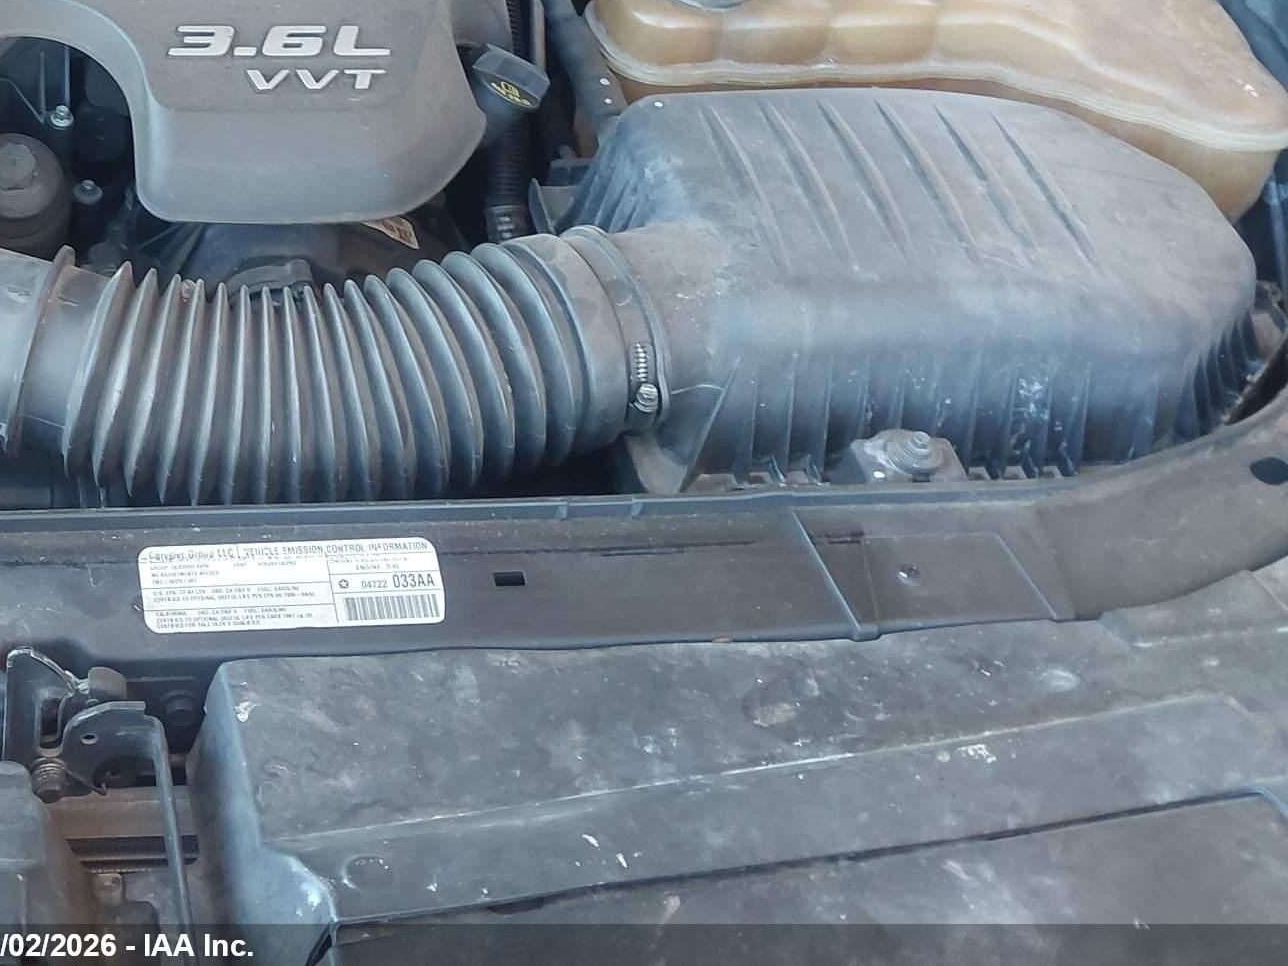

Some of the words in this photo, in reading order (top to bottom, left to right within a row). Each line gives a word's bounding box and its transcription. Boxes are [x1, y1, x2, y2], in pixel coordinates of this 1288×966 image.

[168, 25, 391, 57] 3.6L
[246, 69, 387, 90] VVT
[217, 548, 235, 559] LLC
[244, 546, 279, 557] VEHICLE
[282, 545, 323, 555] EMISSION
[326, 544, 365, 554] CONTROL
[368, 542, 428, 552] INFORMATION
[361, 580, 388, 589] 04722
[392, 573, 436, 588] 033AA
